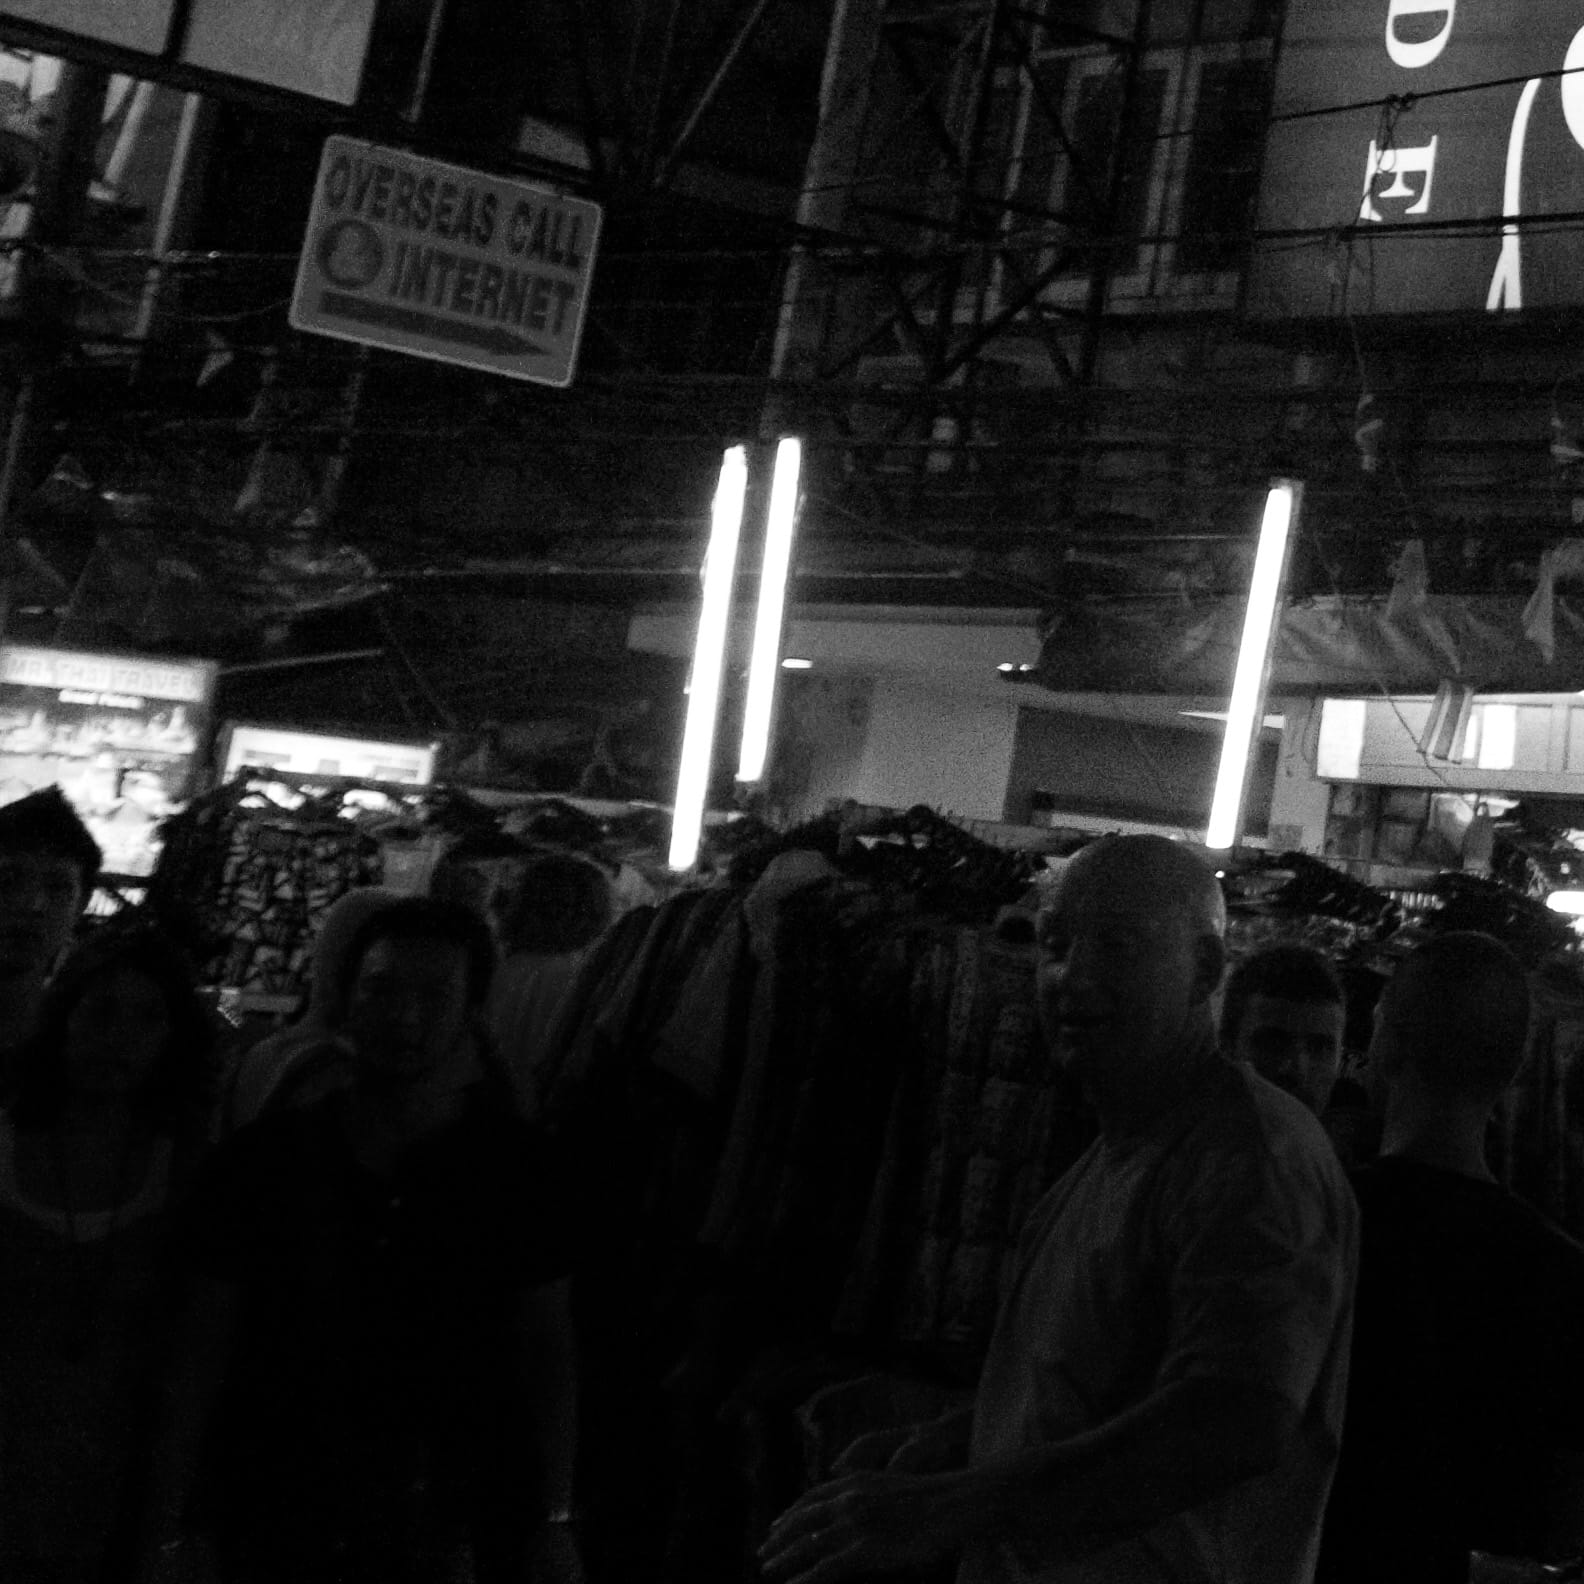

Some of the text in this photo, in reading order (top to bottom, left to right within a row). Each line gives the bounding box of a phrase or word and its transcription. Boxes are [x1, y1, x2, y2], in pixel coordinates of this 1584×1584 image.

[324, 155, 585, 270] OVERSEAS CALL
[389, 241, 577, 336] INTERNET
